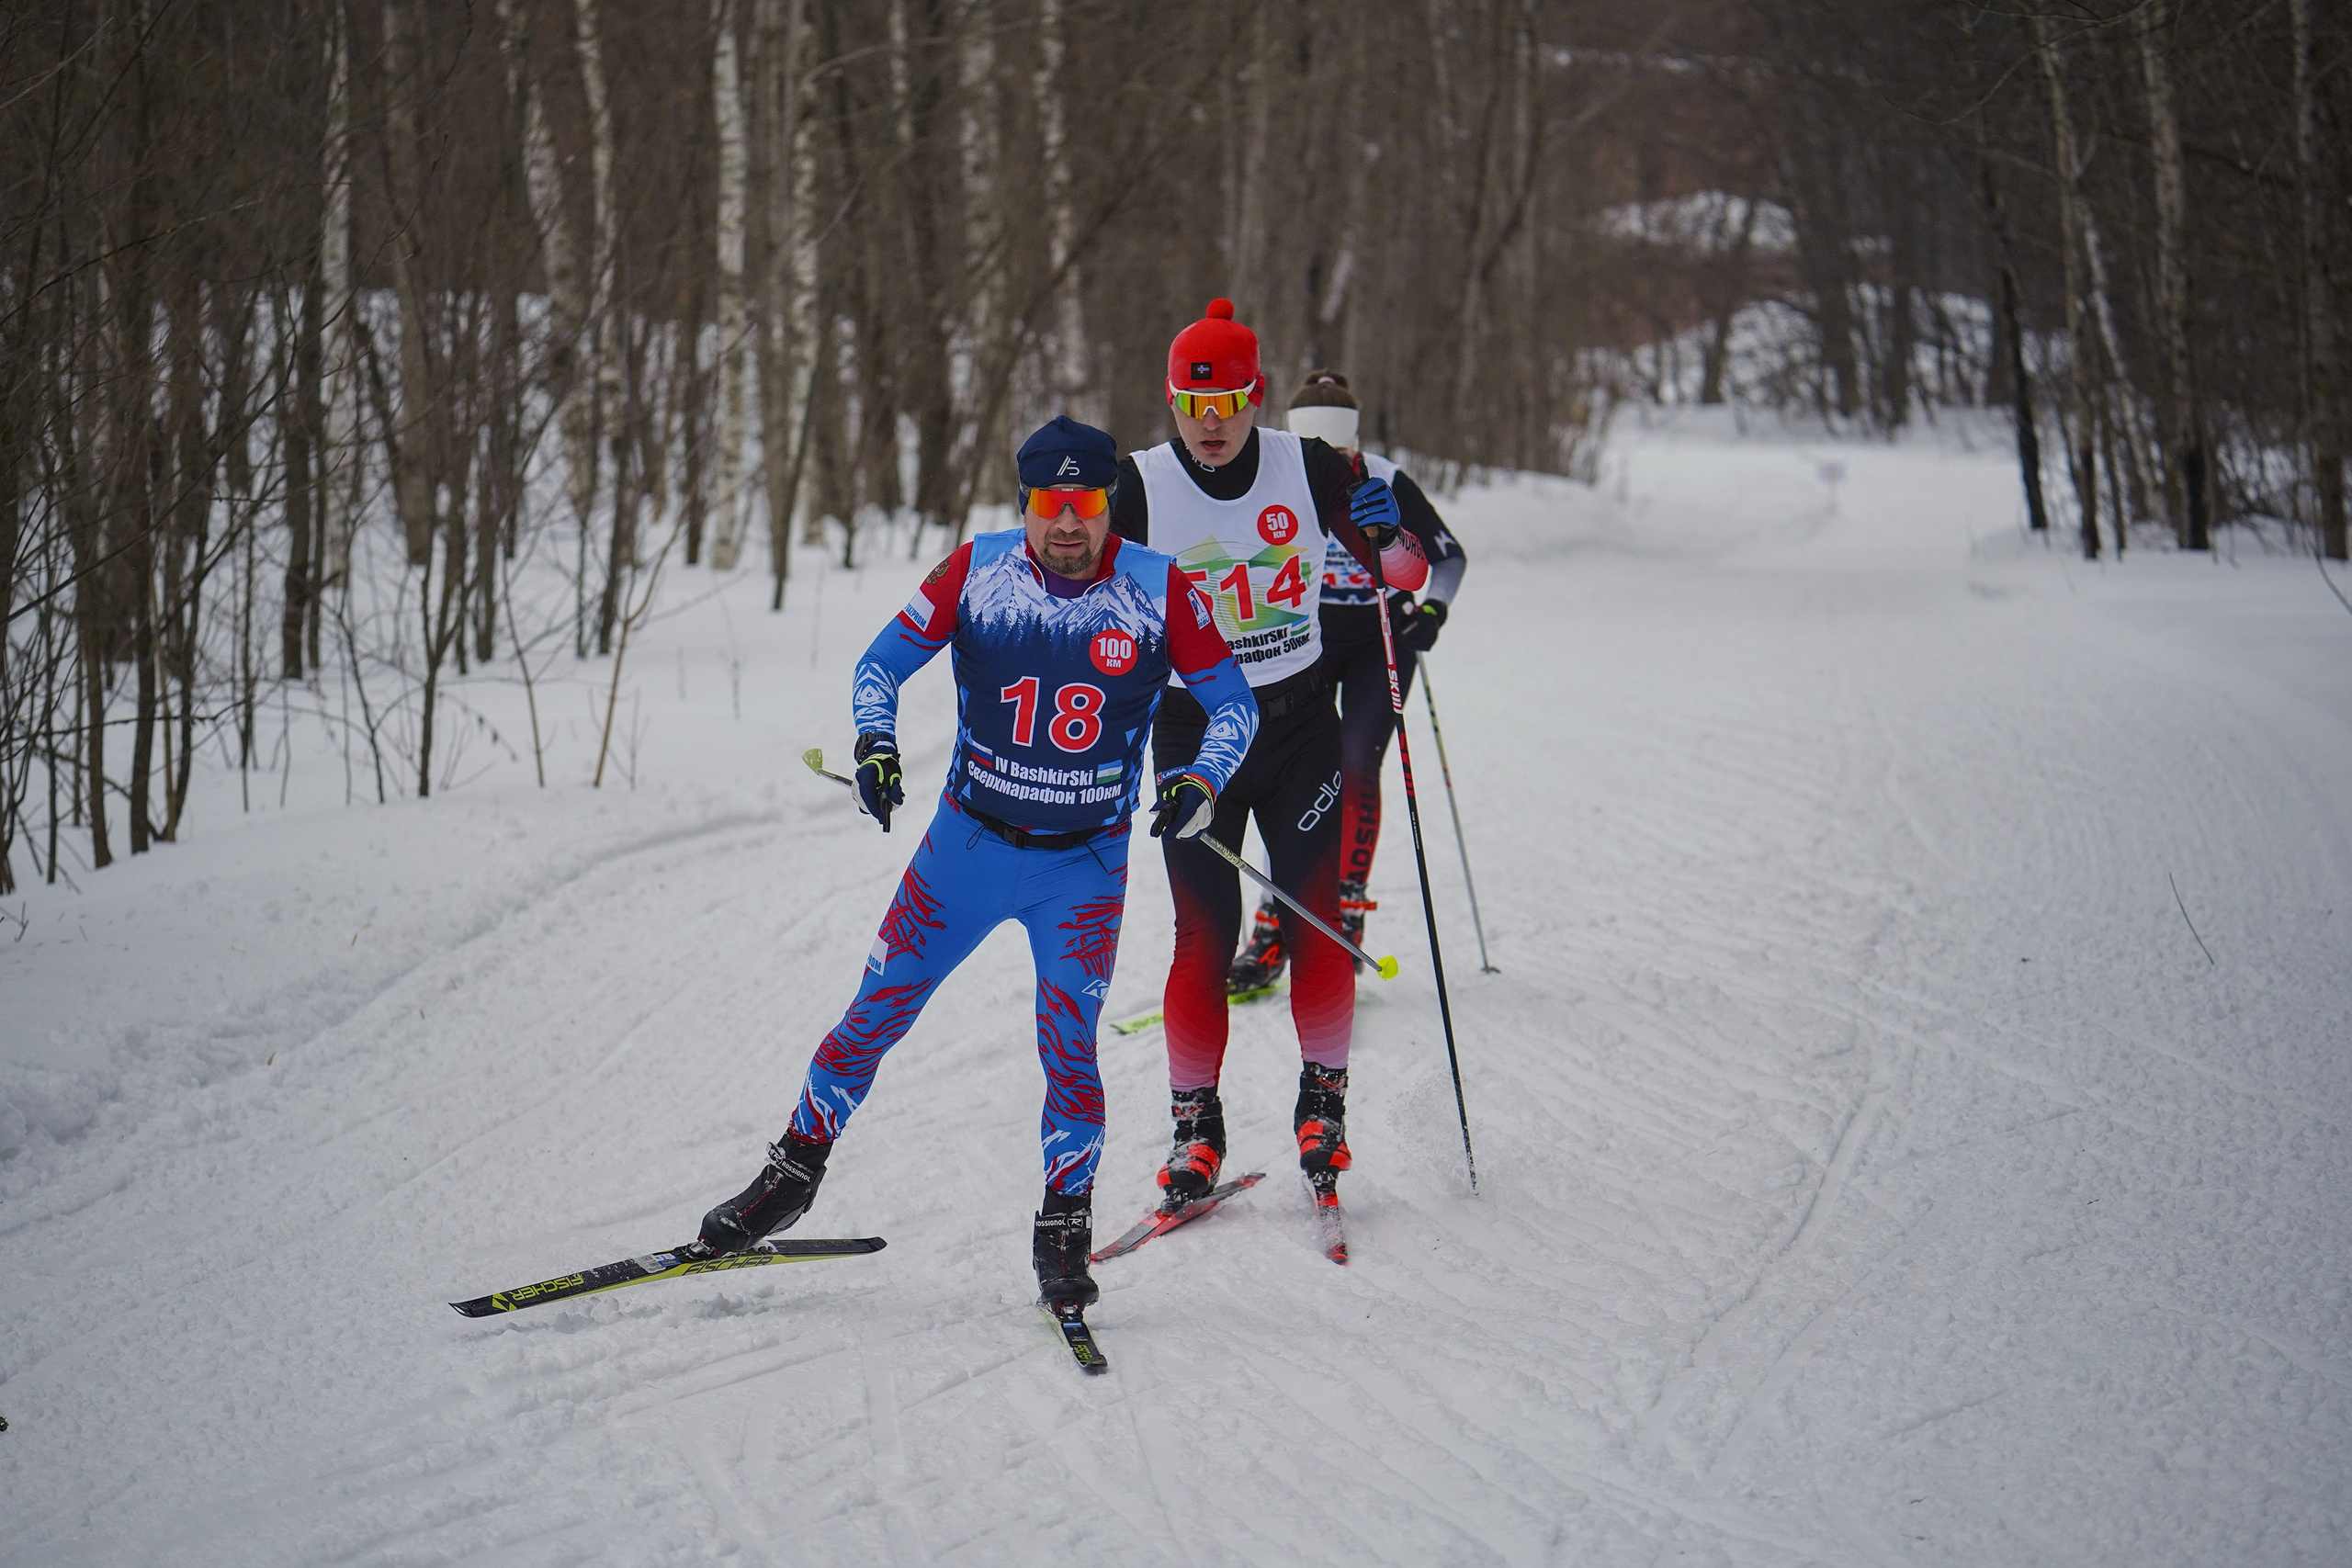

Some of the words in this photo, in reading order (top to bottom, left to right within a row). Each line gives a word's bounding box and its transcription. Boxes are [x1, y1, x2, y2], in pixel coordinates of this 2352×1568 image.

[1265, 512, 1289, 531] 50
[1097, 637, 1132, 660] 100
[1226, 626, 1289, 650] ashkirSki
[1234, 645, 1283, 665] рафон
[1000, 675, 1106, 753] 18
[967, 760, 1076, 805] Сверхмарафон
[995, 755, 1009, 774] IV
[1010, 761, 1094, 787] BashkirSki
[1162, 767, 1187, 779] LAPUA
[1297, 771, 1341, 831] odlo
[682, 1255, 774, 1276] FISCHER
[509, 1273, 584, 1302] FISCHER
